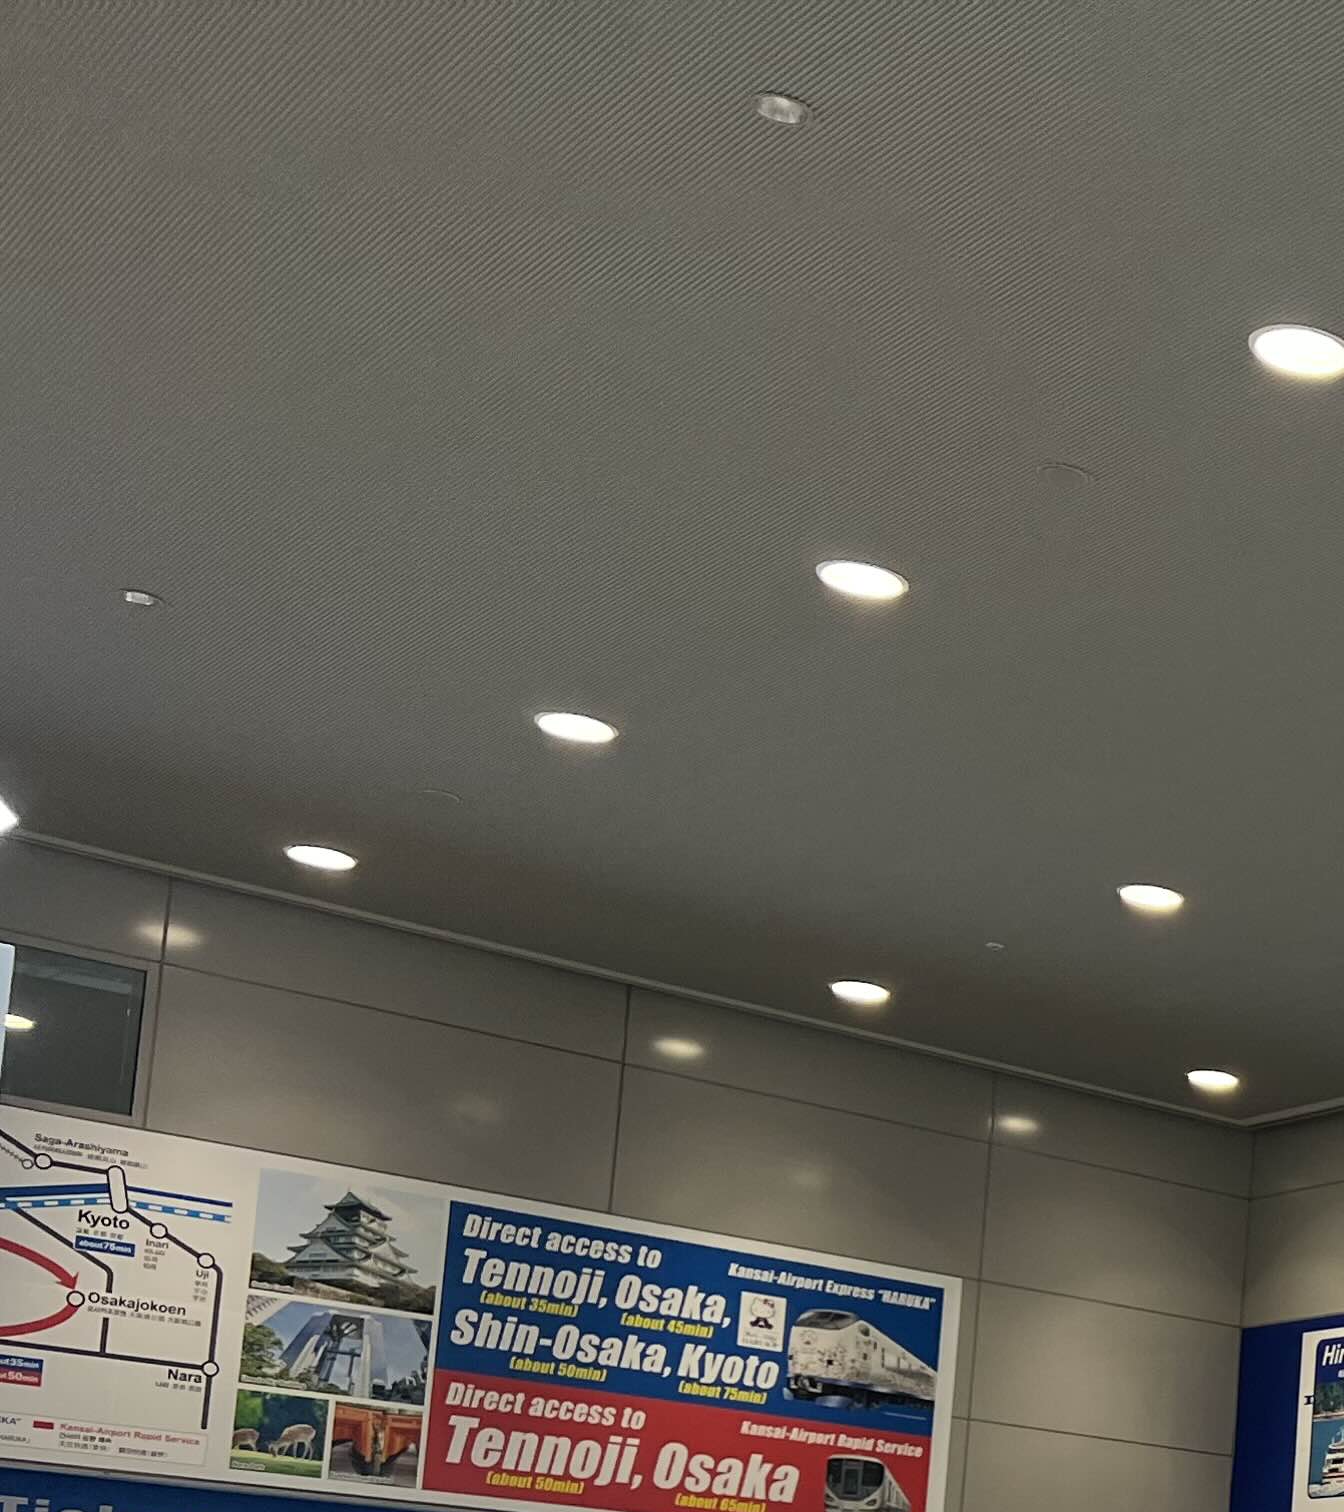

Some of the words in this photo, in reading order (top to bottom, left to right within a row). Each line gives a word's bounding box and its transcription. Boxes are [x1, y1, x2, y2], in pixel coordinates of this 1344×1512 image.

[34, 1132, 129, 1157] Saga-Arashiyama
[78, 1209, 130, 1230] Kyoto
[462, 1213, 542, 1248] Direct
[545, 1231, 633, 1264] access
[637, 1246, 662, 1268] to
[462, 1248, 607, 1309] Tennoji,
[615, 1274, 731, 1328] Osaka,
[728, 1262, 824, 1291] Kansai-Airport
[825, 1280, 875, 1301] Express
[88, 1291, 186, 1317] Osakajokoen
[480, 1290, 527, 1311] (about
[529, 1298, 579, 1318] 35min)
[620, 1312, 665, 1335] (about
[667, 1320, 714, 1338] 45min)
[451, 1309, 671, 1378] Shin-Osaka,
[677, 1343, 780, 1390] Kyoto
[168, 1368, 202, 1383] Nara
[510, 1356, 554, 1375] (about
[558, 1363, 607, 1382] 50min)
[445, 1381, 525, 1414] Direct
[528, 1397, 616, 1427] access
[621, 1407, 646, 1430] to
[678, 1380, 721, 1398] (about
[723, 1386, 767, 1405] 75min)
[740, 1421, 835, 1446] Kansai-Airport
[837, 1434, 875, 1451] Rapid
[876, 1439, 923, 1458] Service
[446, 1415, 643, 1490] Tennoji,
[653, 1442, 800, 1504] Osaka
[486, 1470, 532, 1489] (about
[536, 1477, 584, 1494] 50min)
[675, 1492, 717, 1511] (about
